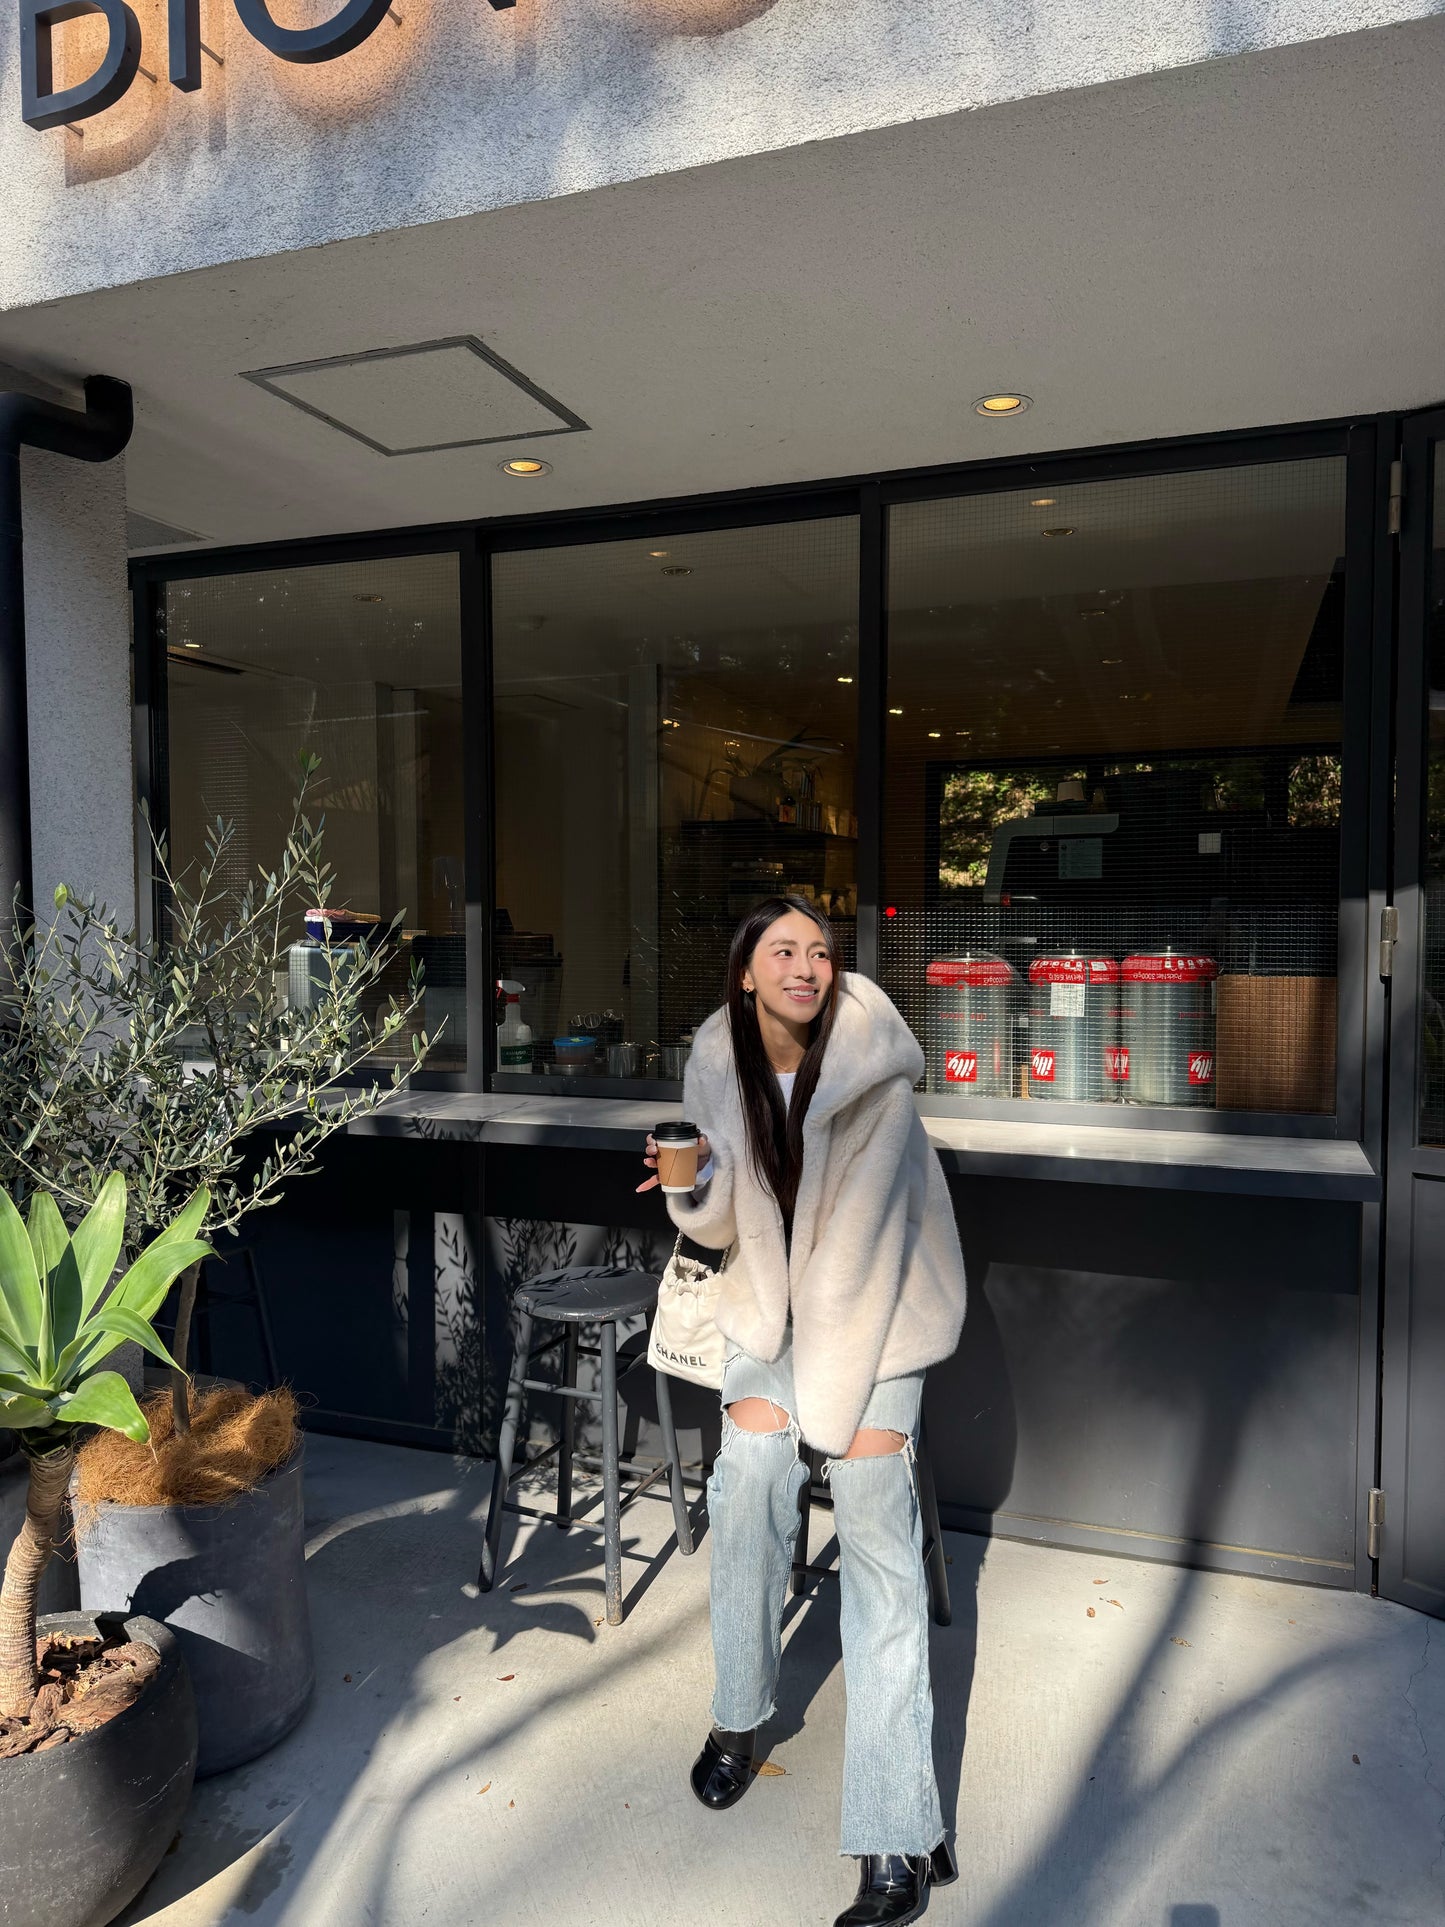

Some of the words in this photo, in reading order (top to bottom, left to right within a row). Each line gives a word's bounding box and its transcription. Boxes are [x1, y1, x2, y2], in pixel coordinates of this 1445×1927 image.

[948, 1053, 975, 1077] illy
[1032, 1052, 1052, 1076] illy
[1190, 1055, 1213, 1079] illy
[656, 1343, 706, 1367] CHANEL
